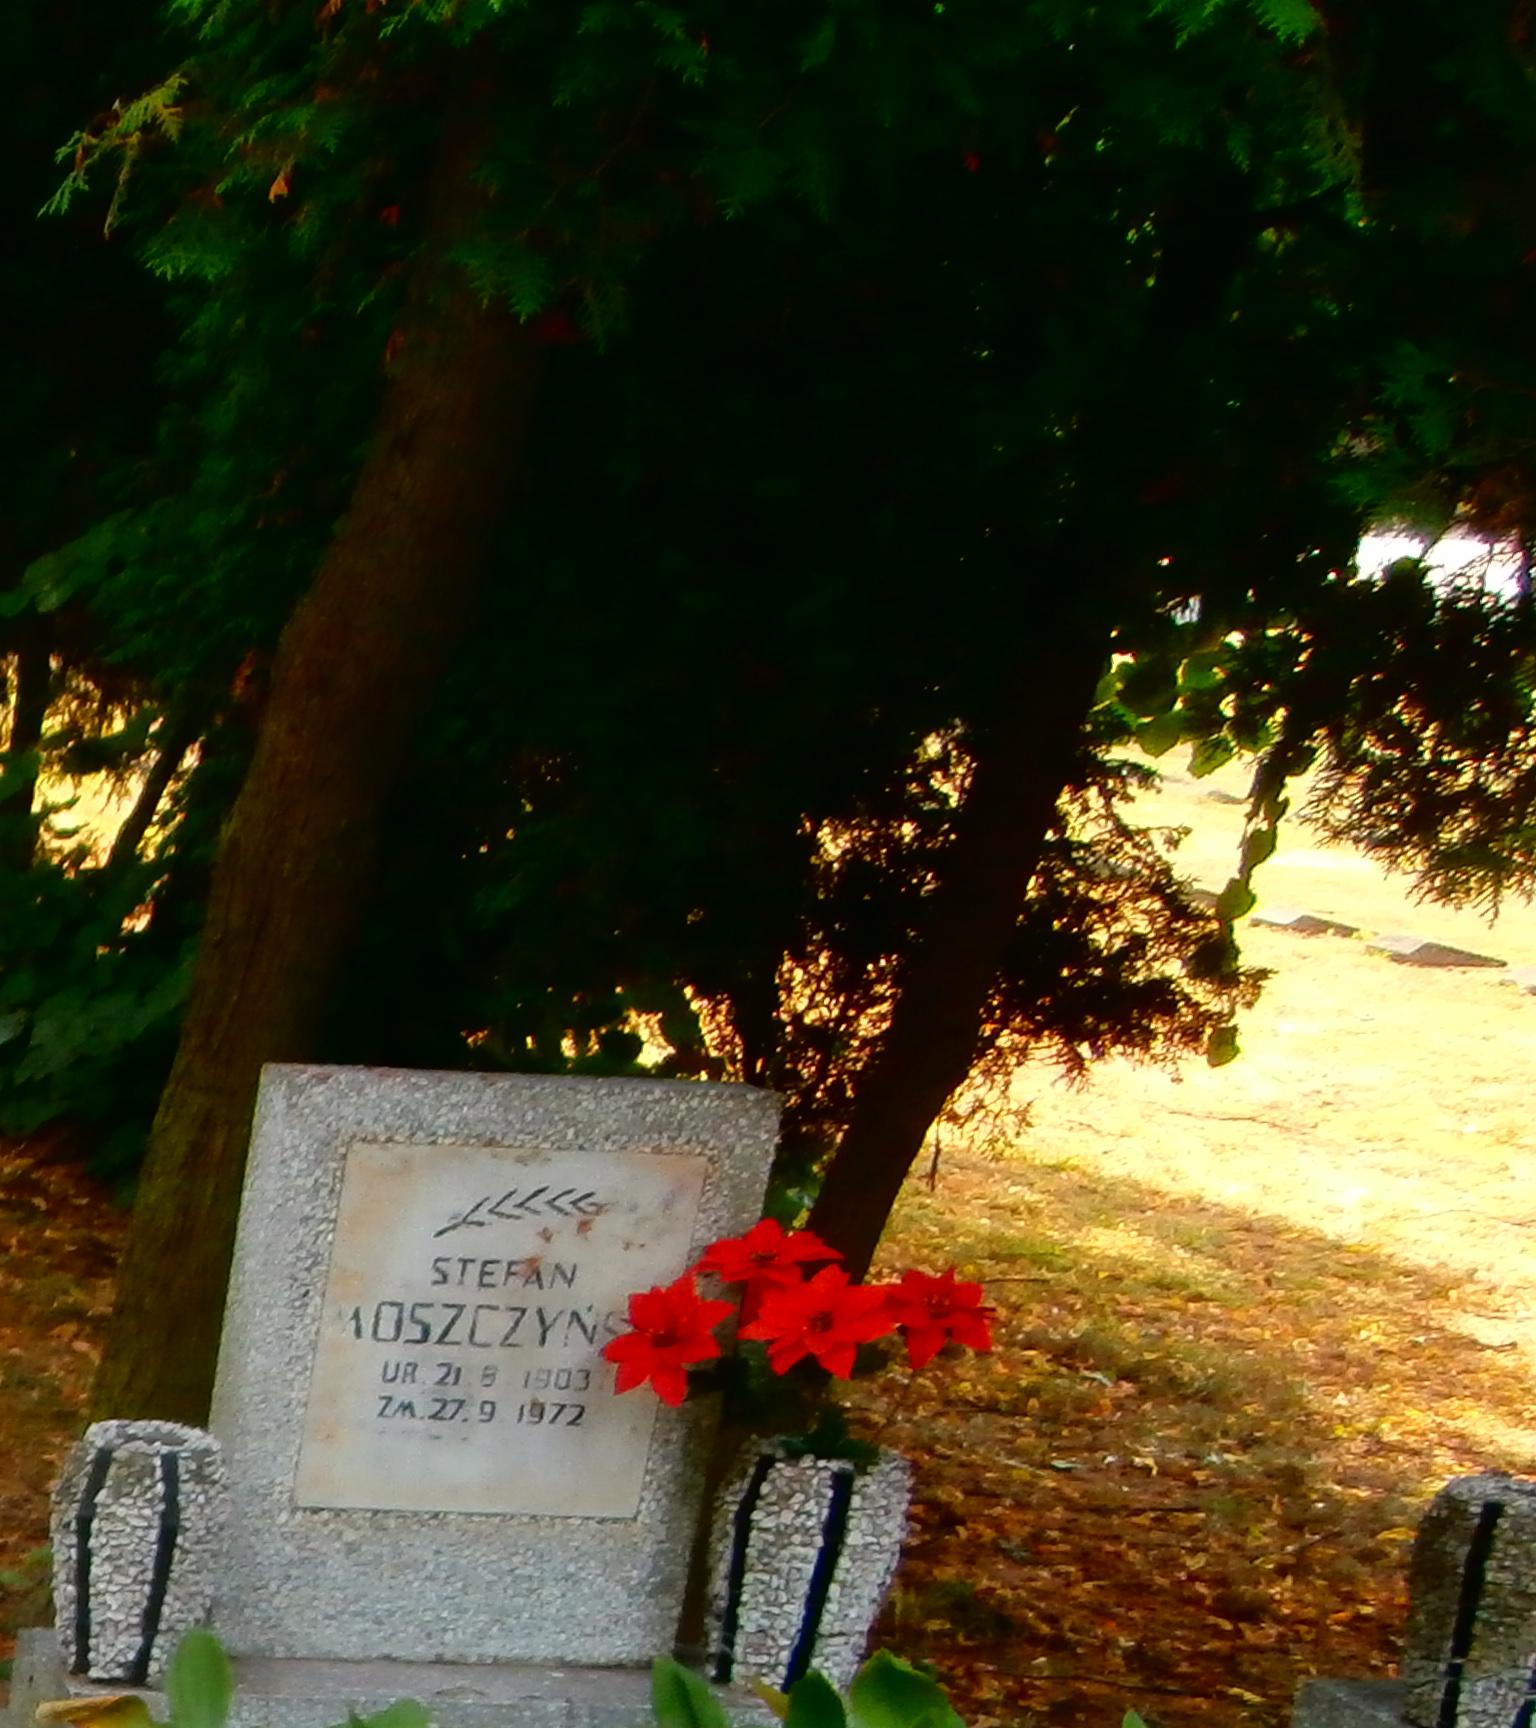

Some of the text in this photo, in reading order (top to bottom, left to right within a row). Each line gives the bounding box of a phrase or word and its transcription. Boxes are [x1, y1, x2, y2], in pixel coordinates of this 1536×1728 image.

[431, 1256, 577, 1290] STEFAN
[521, 1367, 593, 1392] 1903
[478, 1399, 498, 1424] 9
[516, 1402, 587, 1427] 1972
